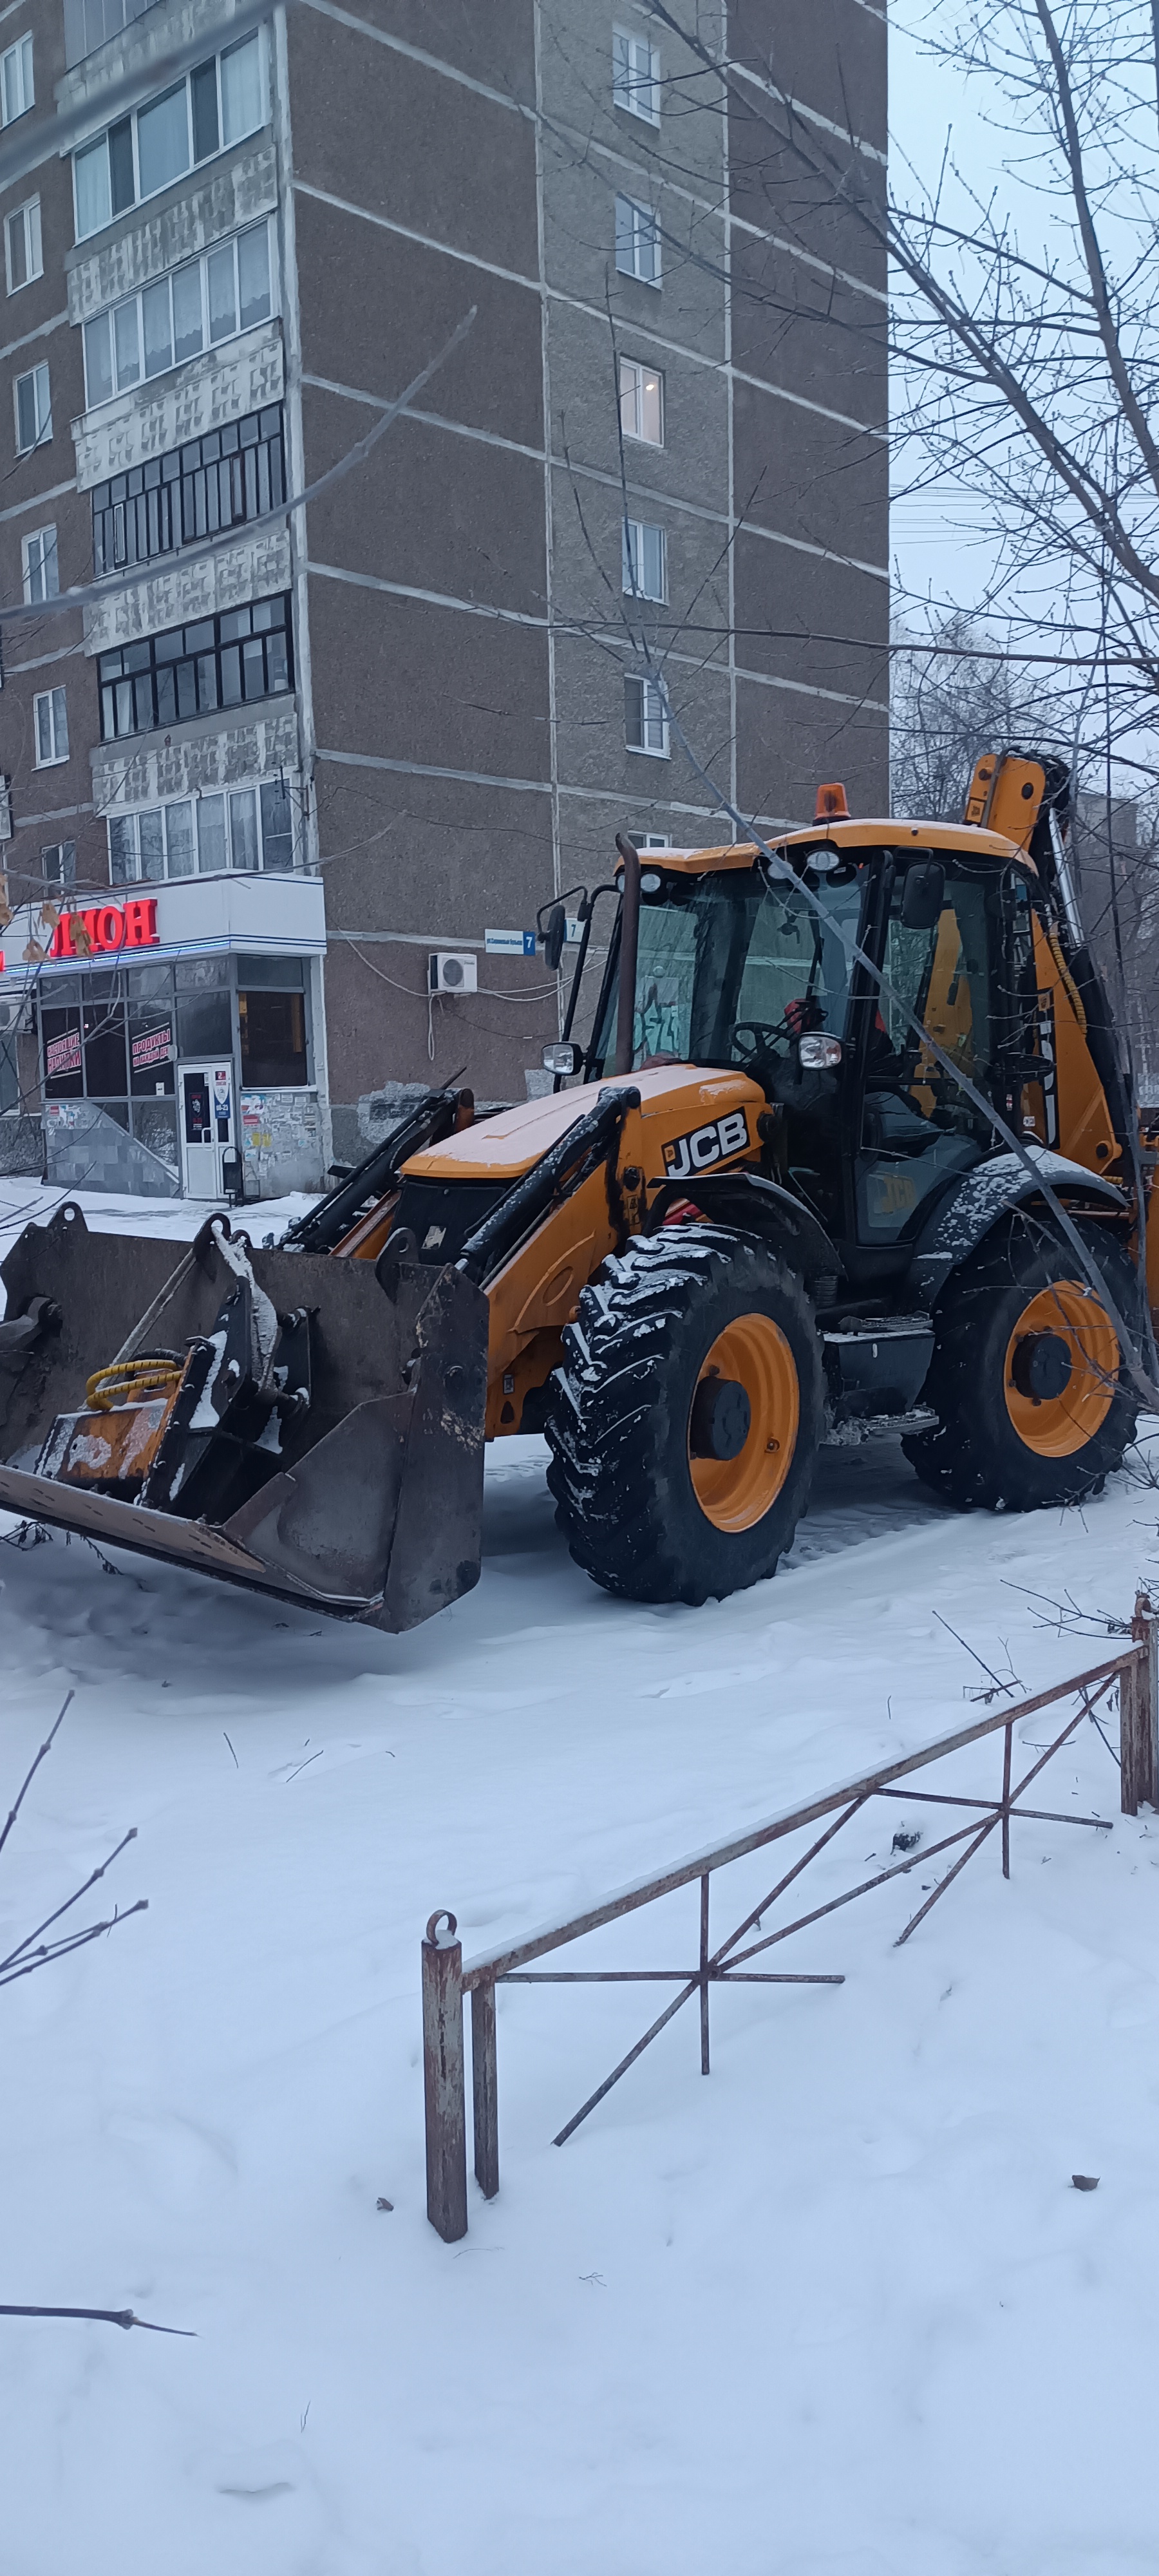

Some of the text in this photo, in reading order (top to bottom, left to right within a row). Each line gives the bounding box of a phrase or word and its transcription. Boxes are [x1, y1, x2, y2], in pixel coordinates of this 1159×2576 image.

[525, 936, 533, 949] 7
[570, 923, 576, 938] 7
[47, 1032, 80, 1057] НАСТОЯЩИЕ
[133, 1028, 171, 1055] ПРОДУКТЫ
[667, 1113, 748, 1177] JCB
